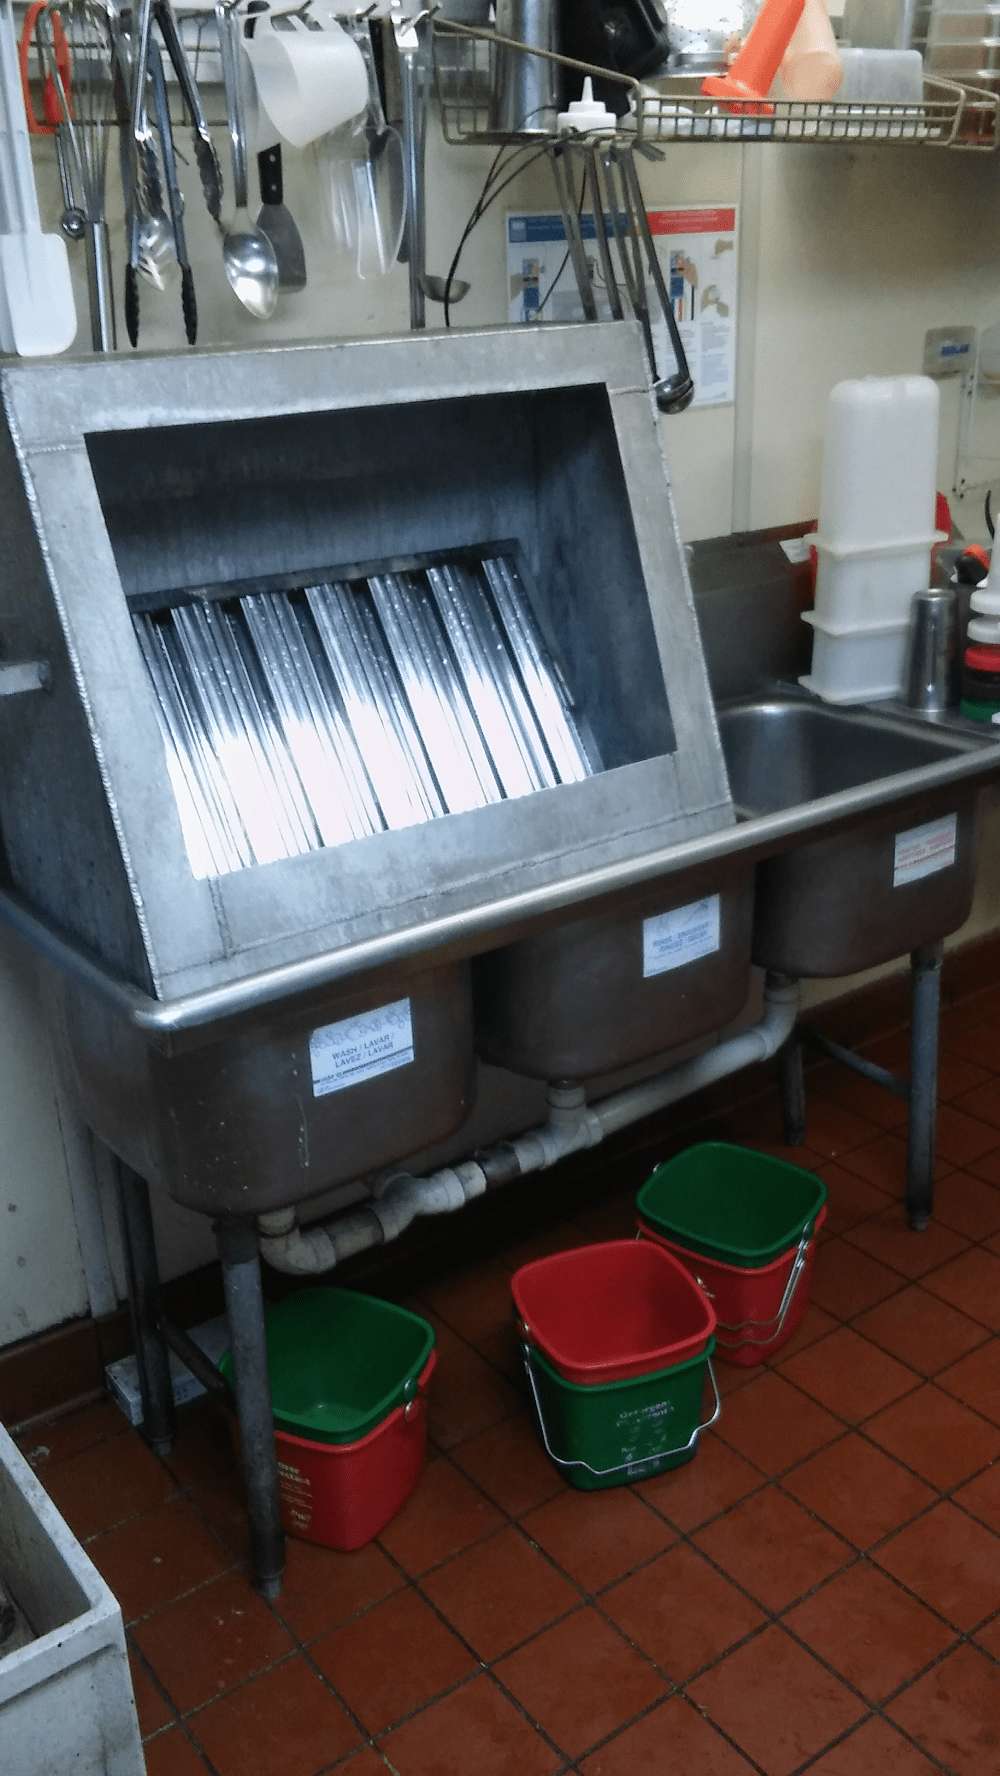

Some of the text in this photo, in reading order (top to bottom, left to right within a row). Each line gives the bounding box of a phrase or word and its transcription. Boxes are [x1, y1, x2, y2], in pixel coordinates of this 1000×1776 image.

[331, 1046, 357, 1060] WASH
[363, 1034, 390, 1049] LAVAR
[334, 1053, 361, 1068] LAVEZ
[367, 1041, 394, 1057] LAVAR
